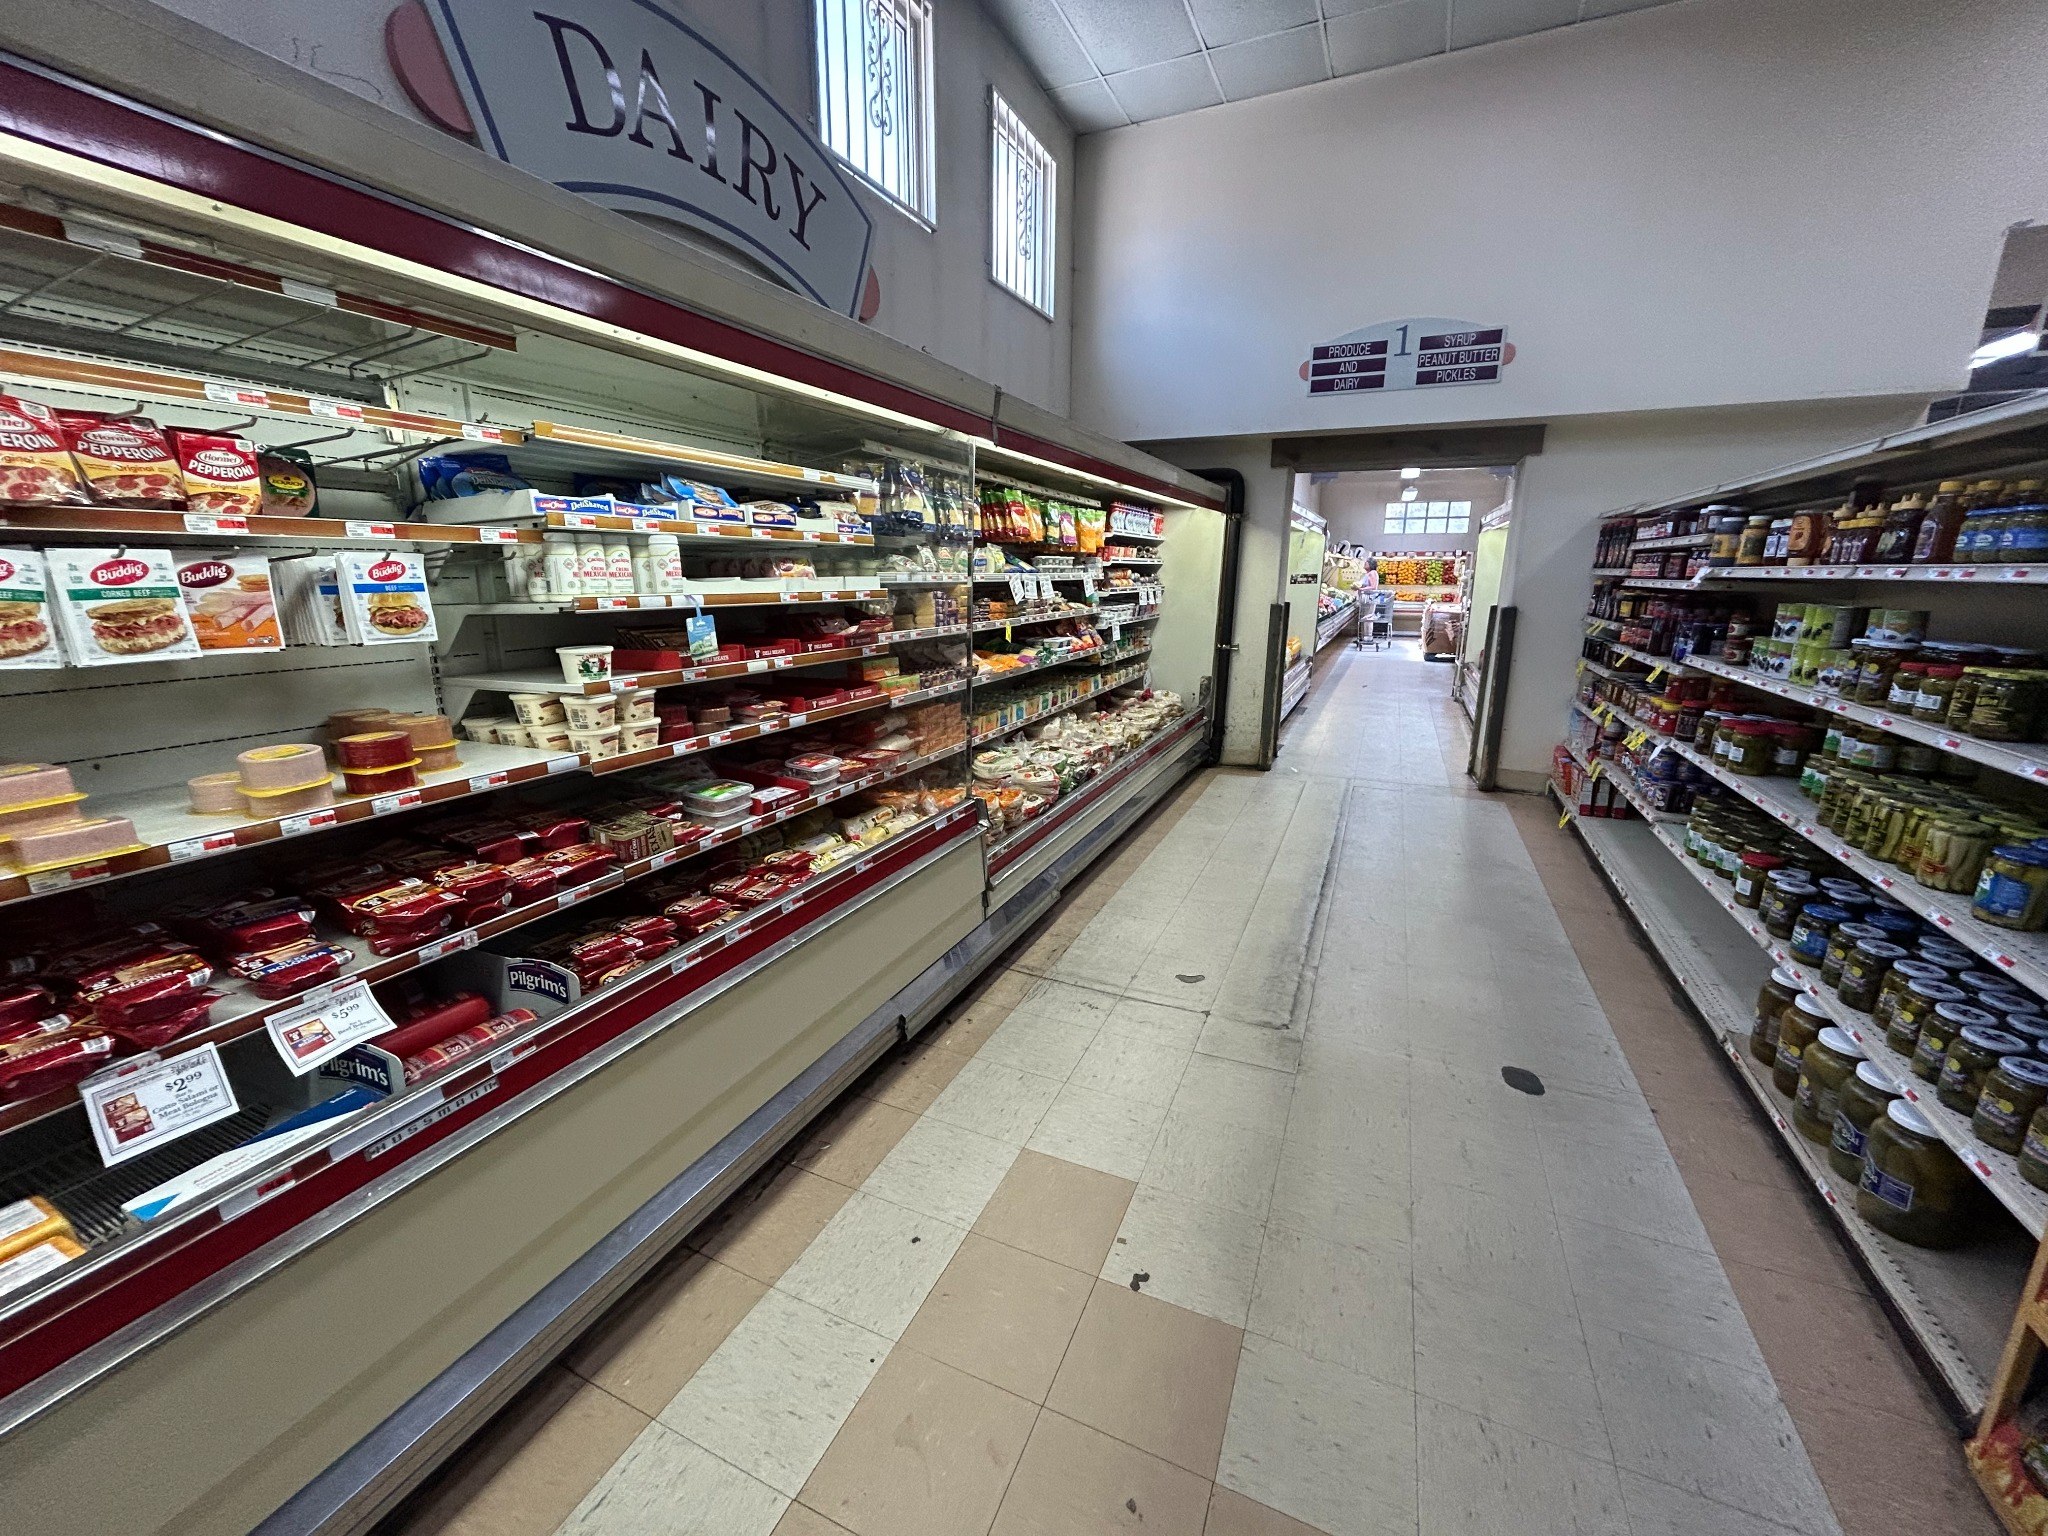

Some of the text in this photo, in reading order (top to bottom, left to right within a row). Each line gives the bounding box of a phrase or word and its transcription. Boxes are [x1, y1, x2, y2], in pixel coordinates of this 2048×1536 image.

[533, 11, 826, 250] DAIRY
[1394, 324, 1411, 356] 1
[1443, 334, 1476, 347] SYRUP
[1328, 343, 1371, 358] PRODUCE
[1418, 349, 1498, 367] PEANUT BUTTER
[1339, 361, 1358, 373] AND
[1435, 369, 1476, 382] PICKLES
[1333, 377, 1360, 390] DAIRY
[0, 432, 59, 450] ERONI
[77, 440, 168, 461] PEPPERONI
[203, 453, 238, 464] Hormel
[188, 459, 255, 479] PEPPERONI
[210, 482, 239, 491] Original
[97, 563, 144, 582] Buddig
[180, 565, 228, 584] Buddig
[372, 563, 403, 579] Buddig
[101, 589, 150, 598] CORNED BEEF
[510, 971, 567, 998] Pilgrim's
[178, 1089, 208, 1104] Salami
[208, 1085, 219, 1093] or
[158, 1108, 182, 1120] Meat
[182, 1092, 218, 1113] Bologna
